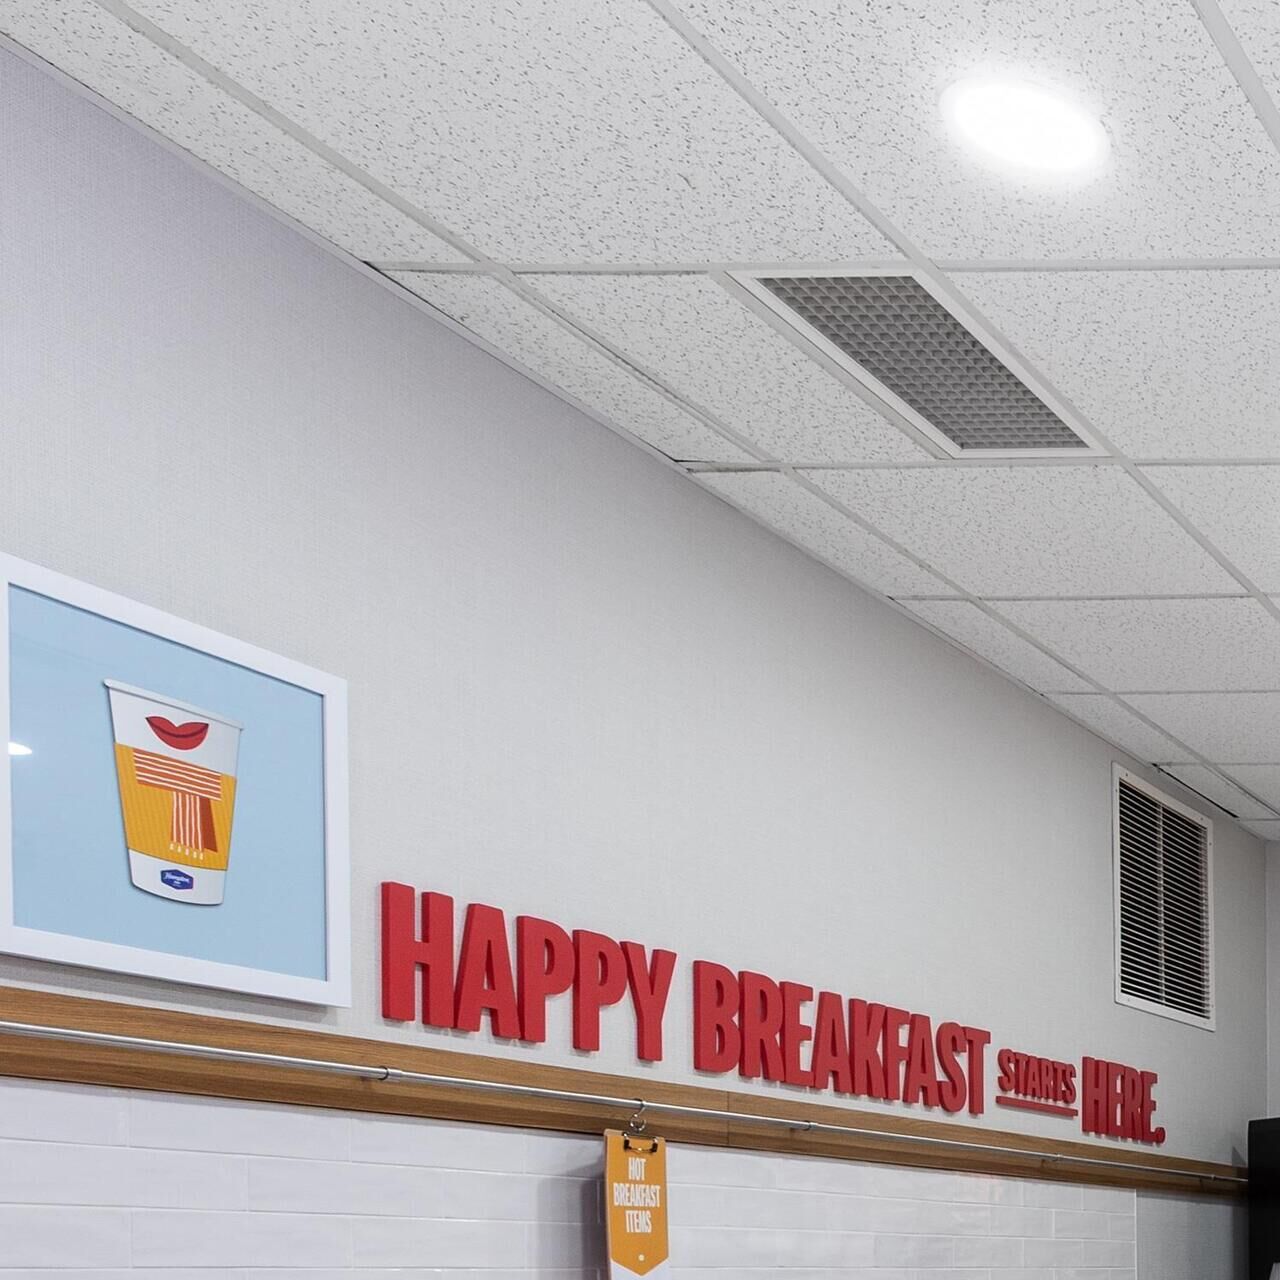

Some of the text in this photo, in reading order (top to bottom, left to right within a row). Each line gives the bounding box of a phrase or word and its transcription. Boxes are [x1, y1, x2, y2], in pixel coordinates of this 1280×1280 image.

[381, 881, 1166, 1144] HAPPY BREAKFAST STARTS HERE.
[628, 1157, 646, 1180] HOT
[613, 1183, 661, 1207] BREAKFAST
[625, 1210, 652, 1233] ITEMS
